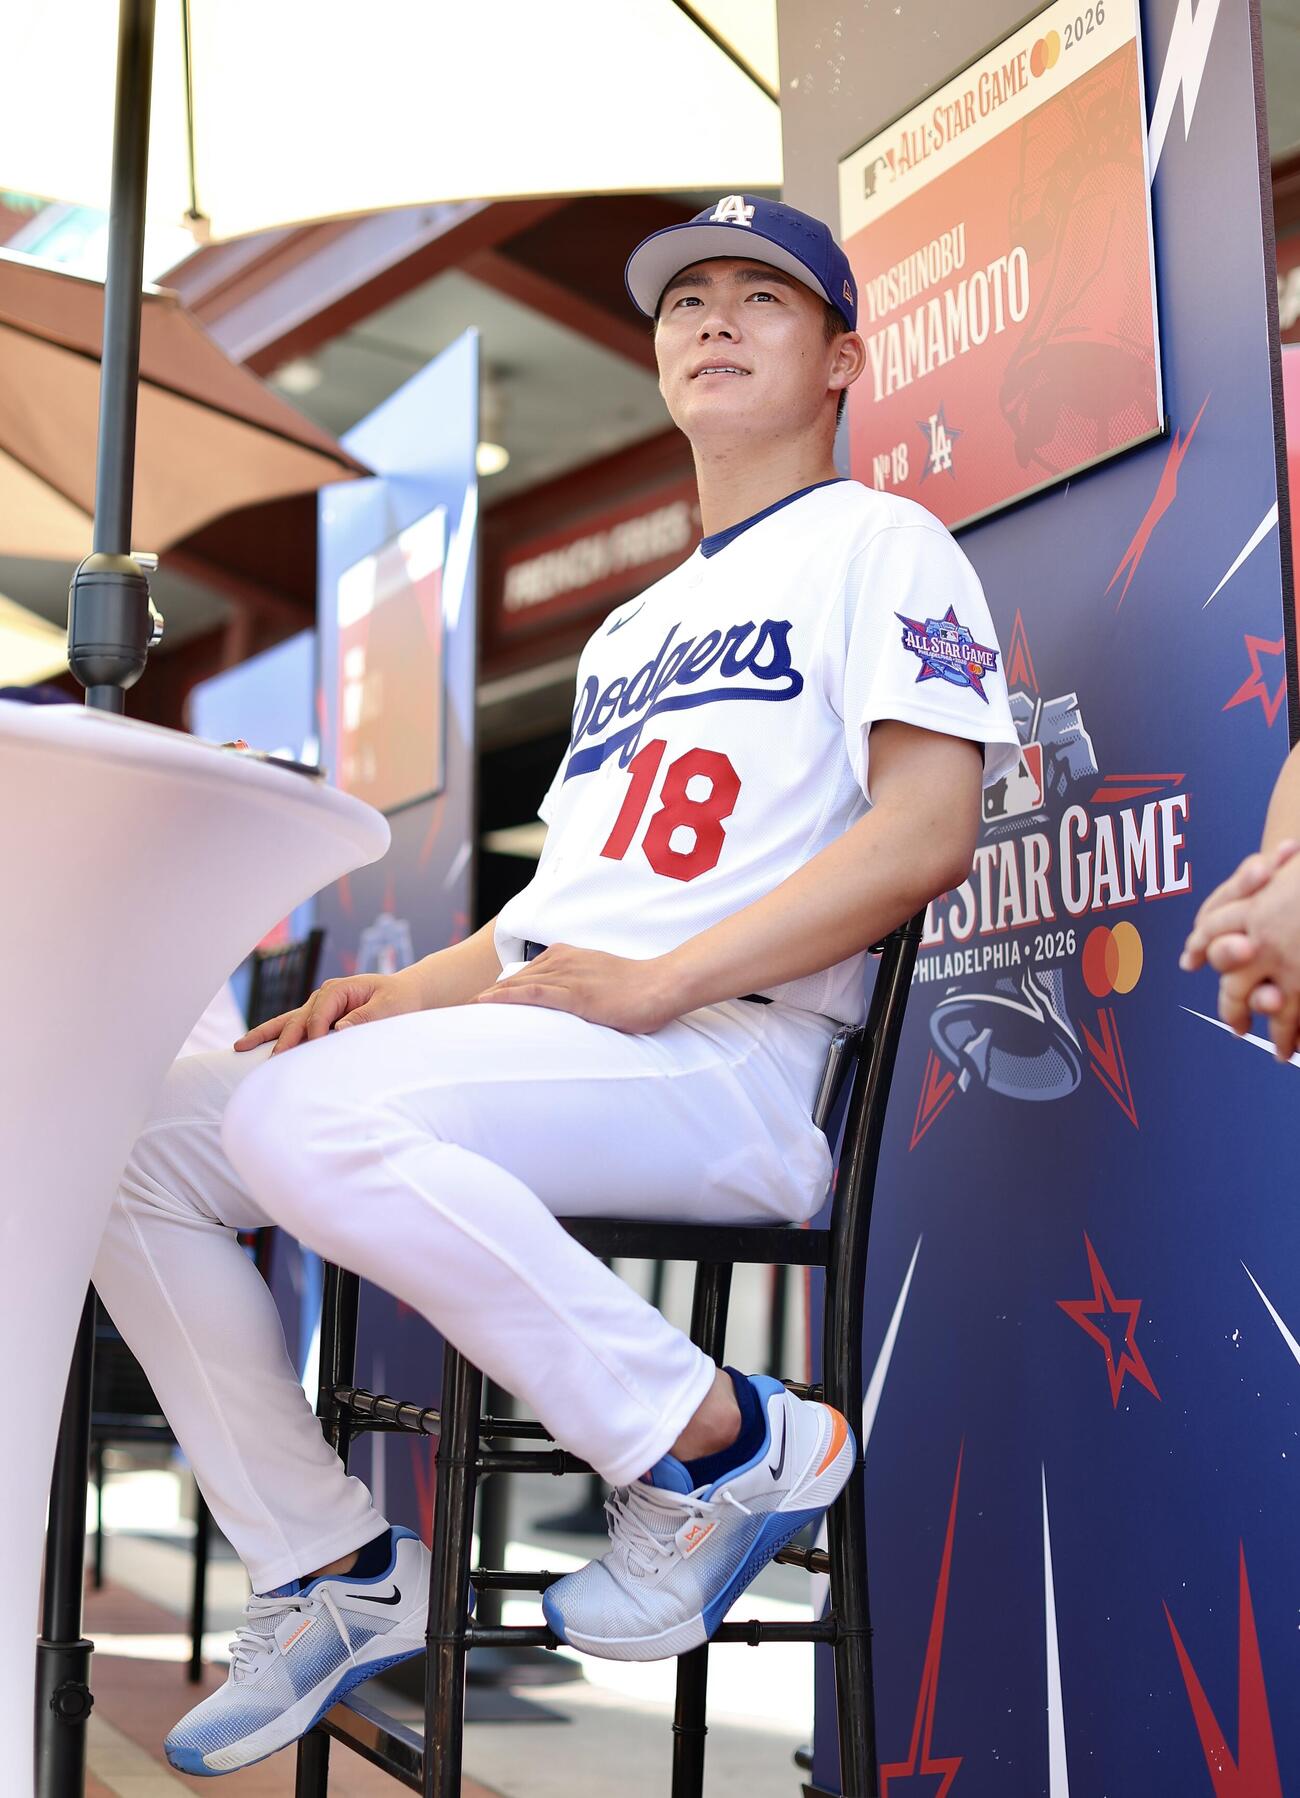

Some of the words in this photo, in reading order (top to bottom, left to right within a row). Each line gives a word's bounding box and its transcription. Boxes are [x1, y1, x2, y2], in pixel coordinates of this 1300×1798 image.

[978, 50, 1029, 118] GAME
[1064, 0, 1106, 50] 2026
[709, 195, 756, 228] LA
[865, 222, 967, 323] YOSHINOBU
[866, 246, 1030, 402] YAMAMOTO
[928, 414, 952, 475] LA
[569, 618, 800, 769] Dodgers
[931, 636, 961, 659] STAR
[962, 644, 993, 668] GAME
[599, 738, 742, 882] 18
[1059, 794, 1191, 915] GAME
[1034, 929, 1076, 961] 2026
